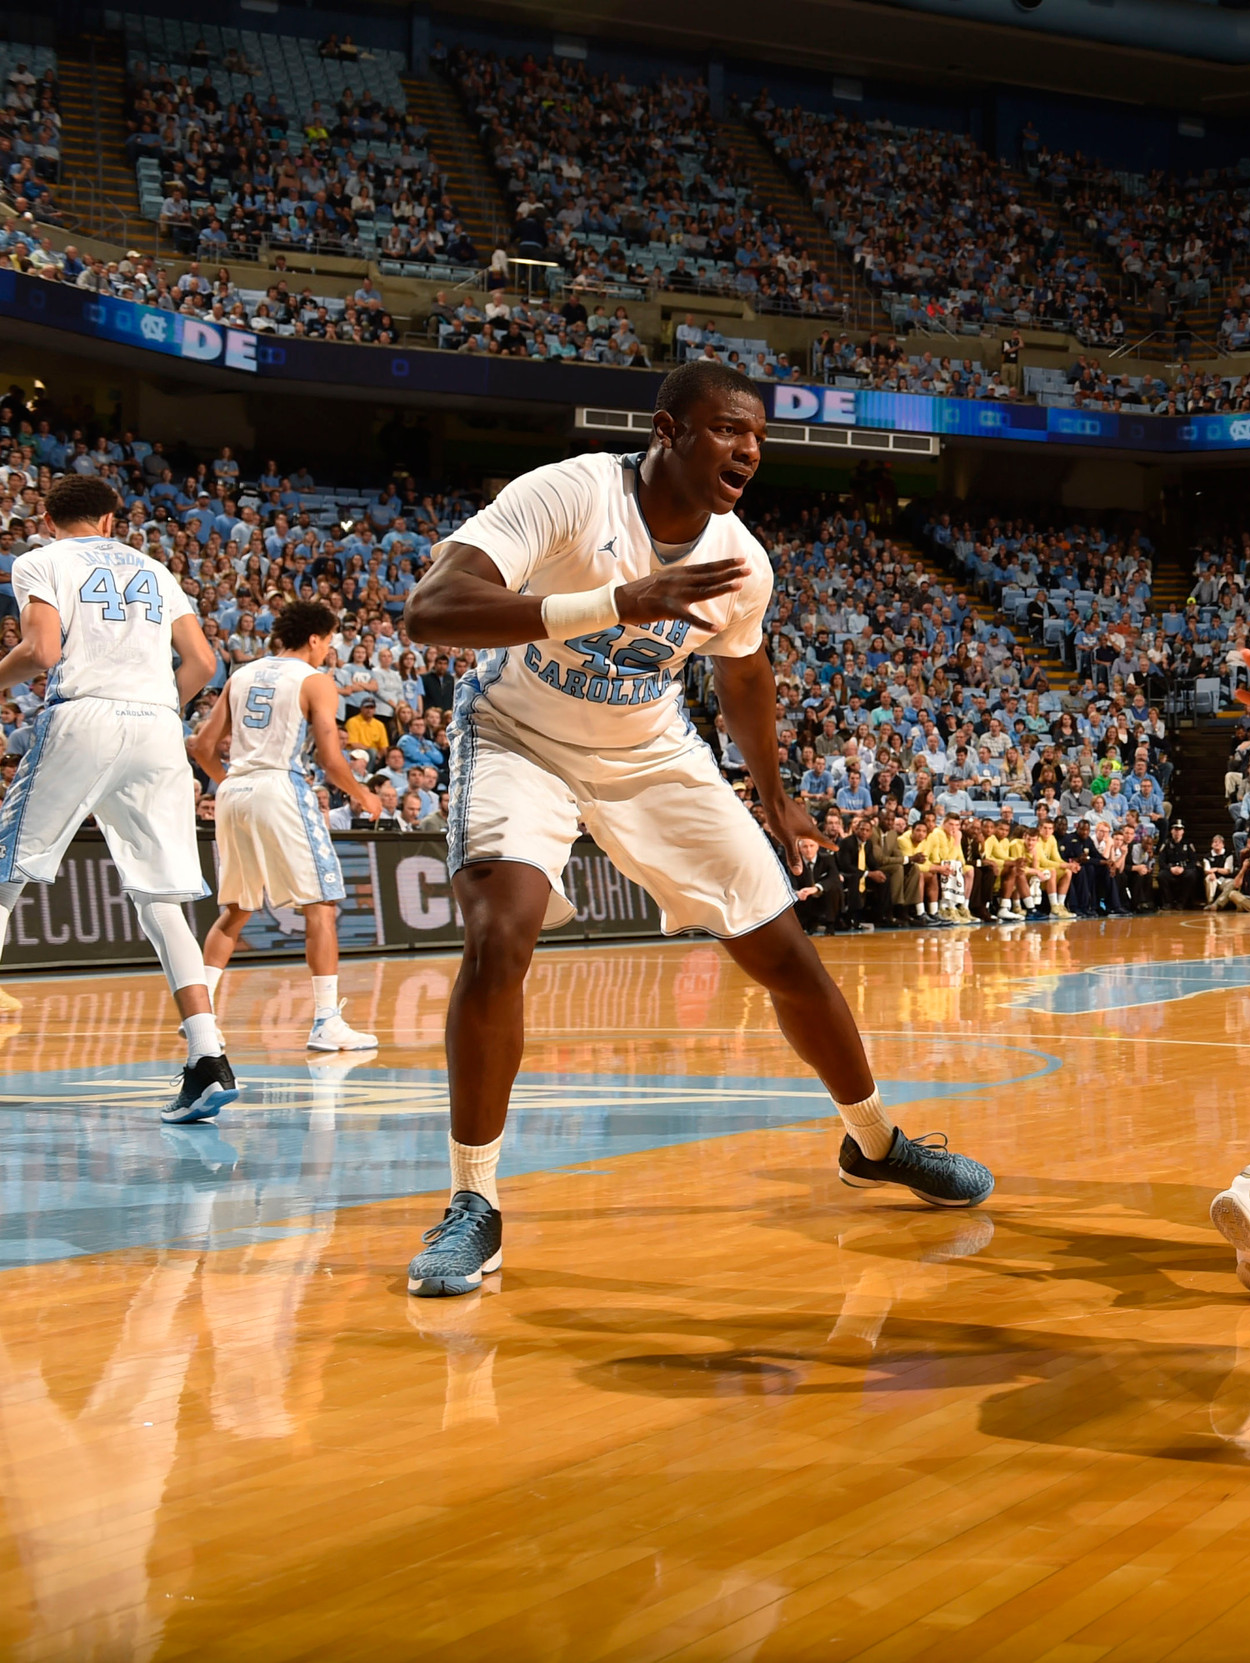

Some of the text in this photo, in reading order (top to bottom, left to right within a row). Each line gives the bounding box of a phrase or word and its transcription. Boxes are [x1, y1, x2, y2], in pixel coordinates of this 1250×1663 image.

[181, 320, 257, 372] DE
[774, 385, 856, 424] DE
[77, 550, 145, 569] JACKSON
[79, 567, 163, 625] 44
[524, 643, 673, 705] CAROLINA
[564, 624, 674, 676] 42
[243, 686, 276, 729] 5
